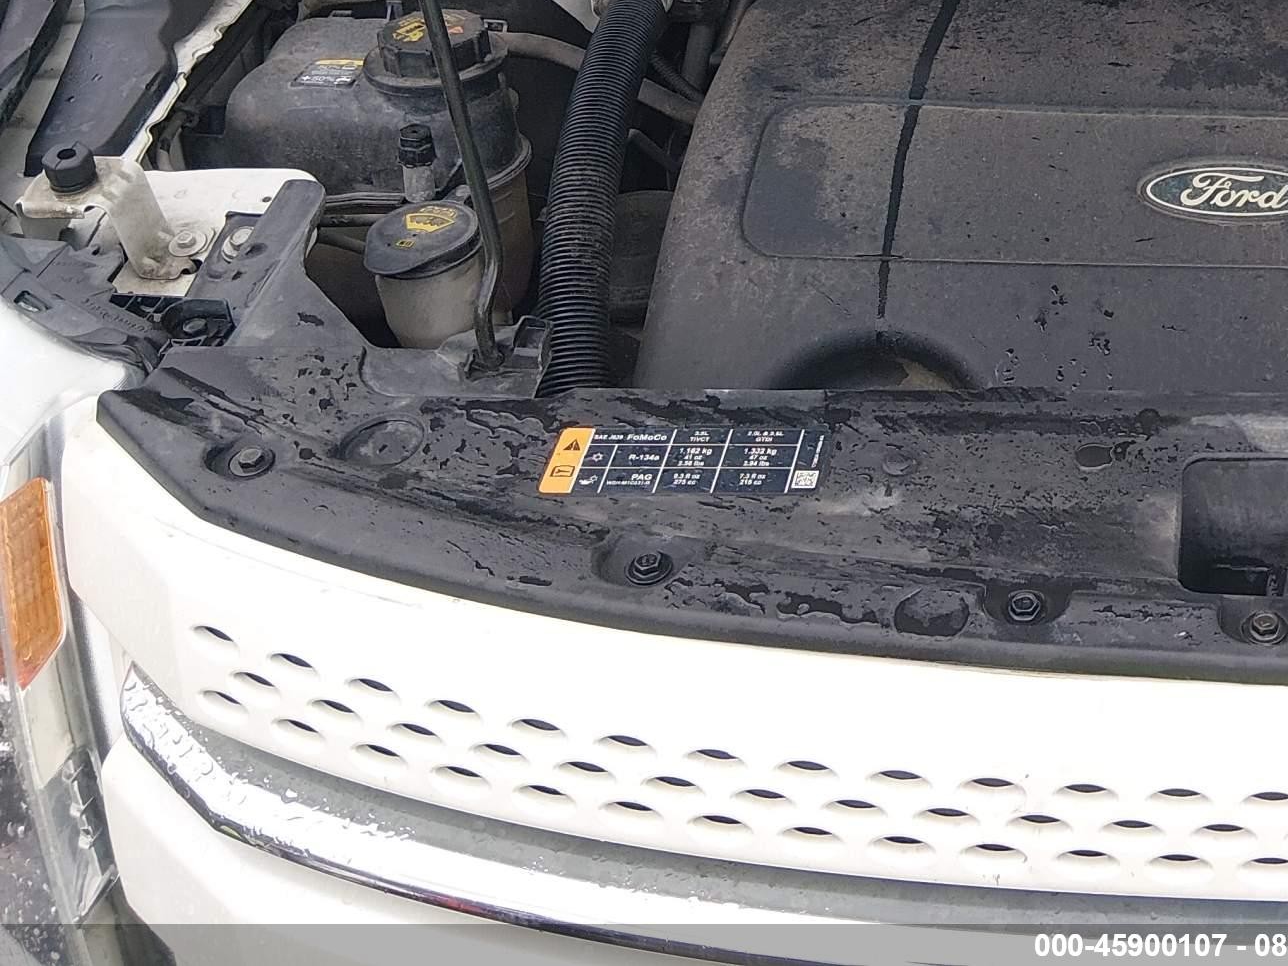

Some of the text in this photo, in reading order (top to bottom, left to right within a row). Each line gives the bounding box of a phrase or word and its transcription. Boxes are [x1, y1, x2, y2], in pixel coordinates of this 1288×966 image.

[626, 433, 667, 441] FoMoCo
[702, 447, 713, 455] kg
[766, 447, 777, 456] kg
[628, 453, 660, 461] R-134a
[631, 473, 653, 481] PAG
